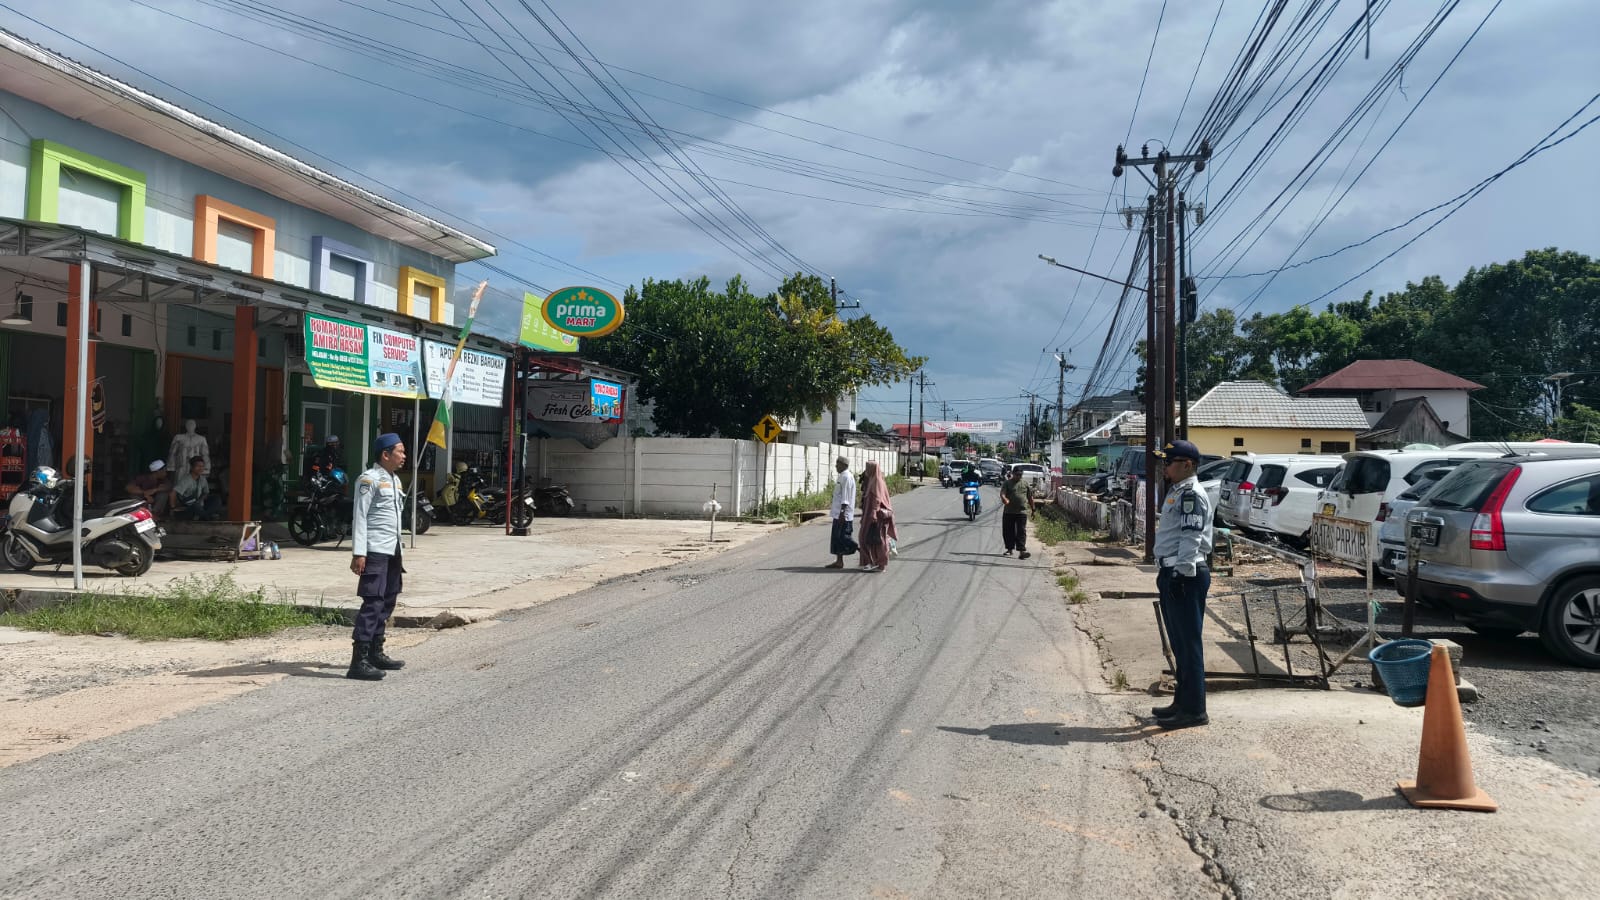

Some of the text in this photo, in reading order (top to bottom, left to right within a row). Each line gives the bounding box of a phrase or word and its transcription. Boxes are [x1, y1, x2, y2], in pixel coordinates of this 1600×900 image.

[556, 304, 606, 318] prima
[310, 317, 364, 341] RUMAH BEKAM
[566, 317, 596, 327] MART
[313, 333, 363, 355] AMIRA HASAN
[383, 333, 416, 351] COMPUTER
[383, 347, 409, 362] SERVICE
[463, 352, 479, 366] REZKI
[480, 356, 504, 369] BAROKAH
[542, 403, 567, 416] Fresh
[1313, 522, 1367, 560] BATAS PARKIR
